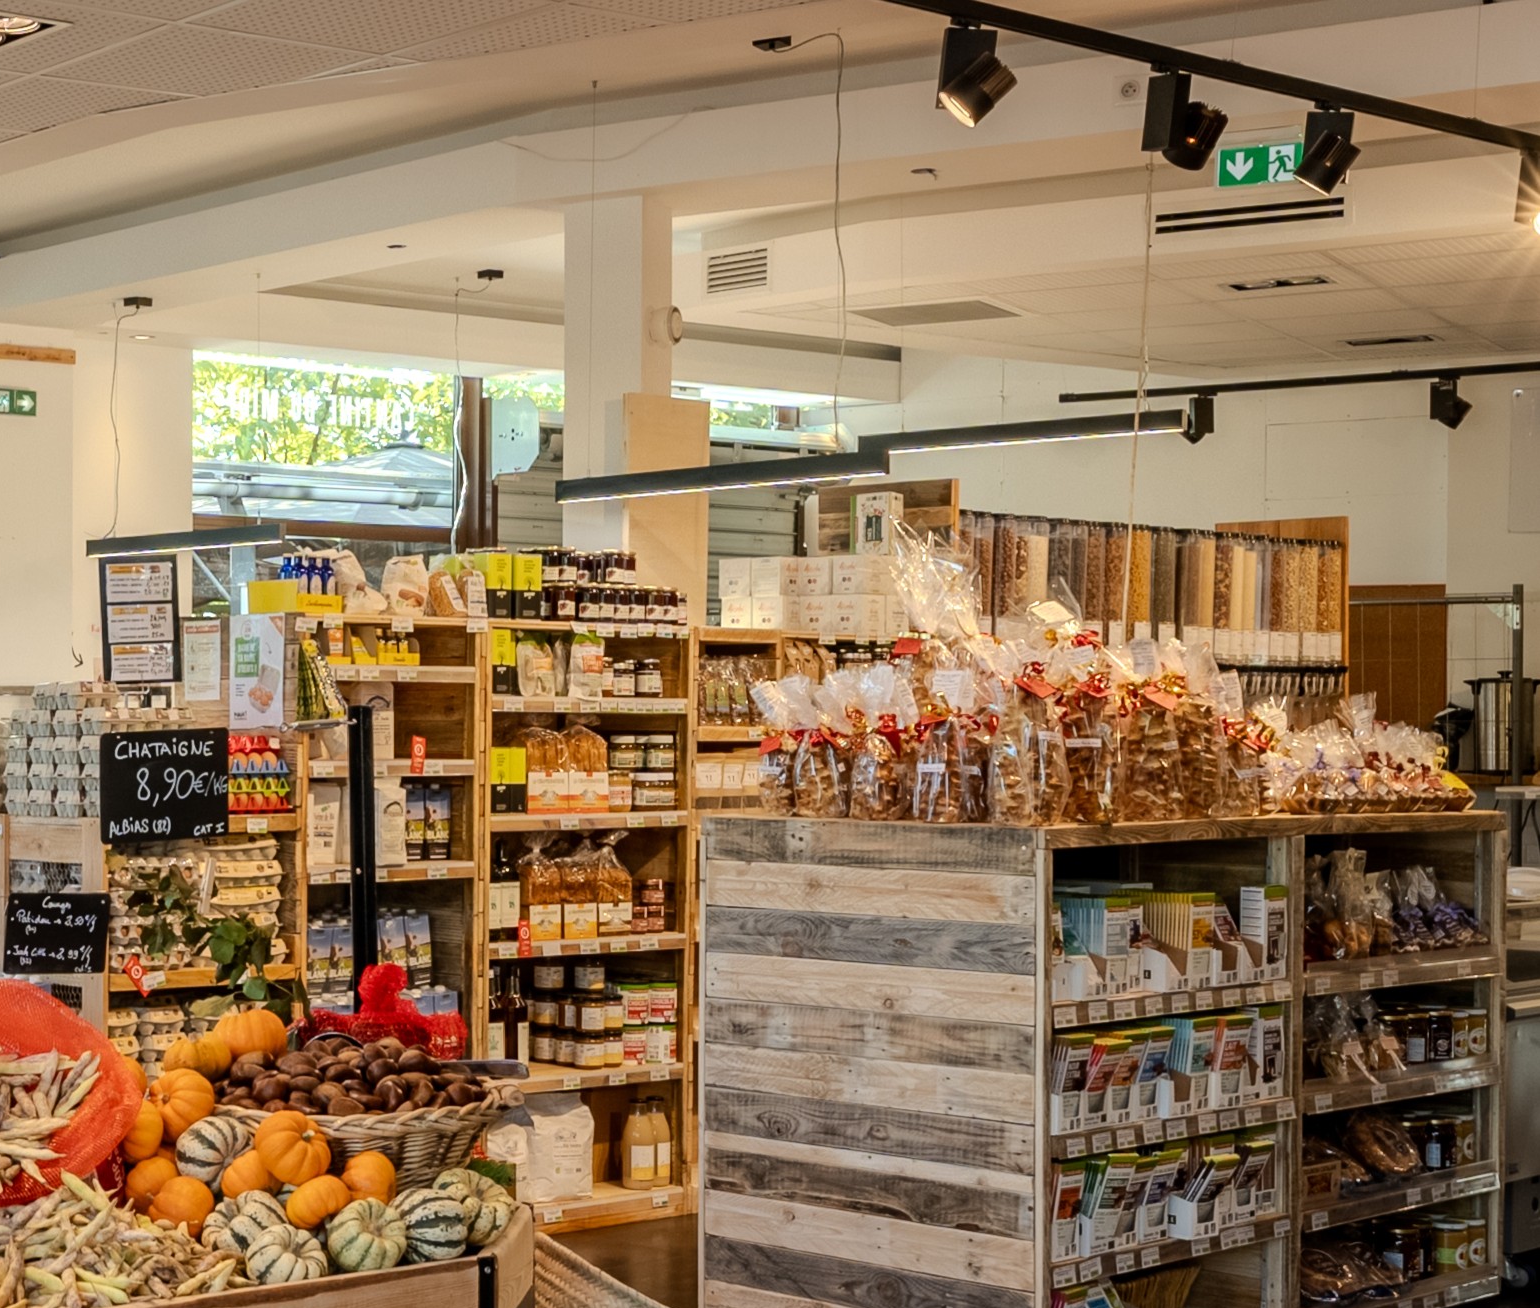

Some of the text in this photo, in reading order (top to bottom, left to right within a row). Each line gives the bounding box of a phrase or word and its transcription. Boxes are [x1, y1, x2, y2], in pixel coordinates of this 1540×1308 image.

[152, 816, 172, 835] (82)
[193, 822, 225, 836] CAT I
